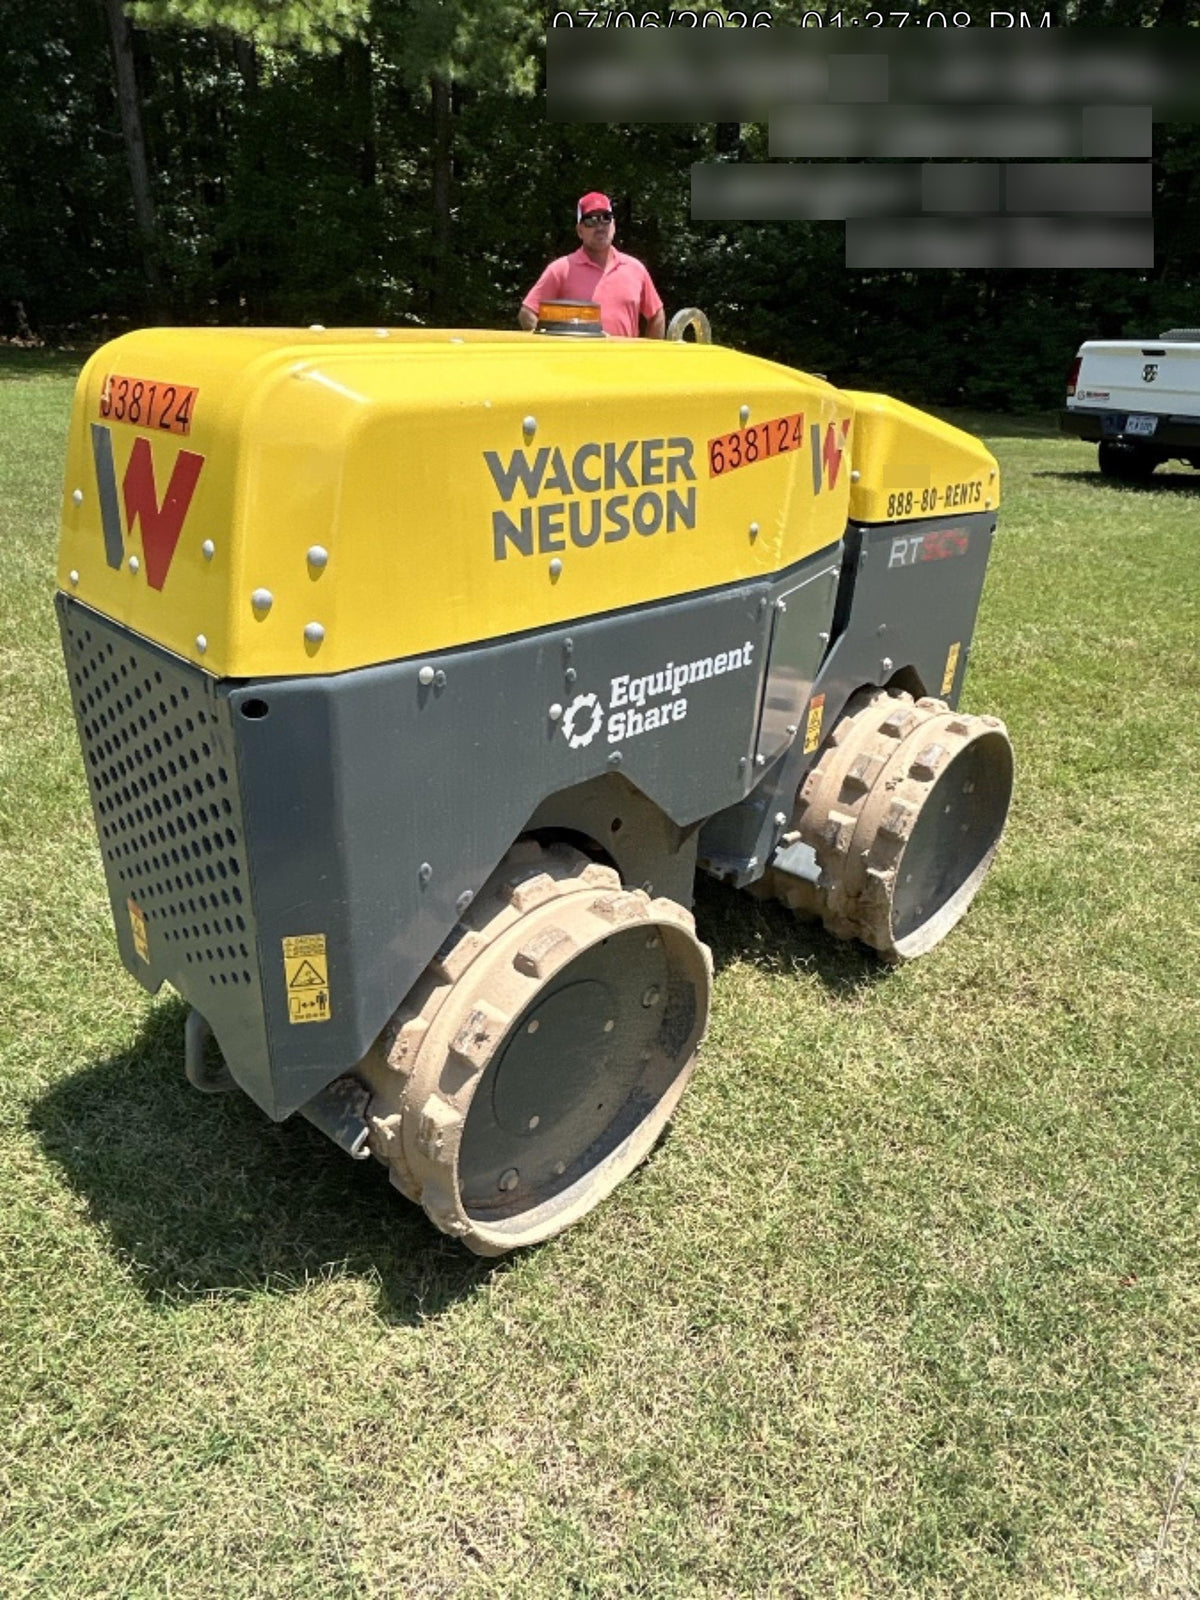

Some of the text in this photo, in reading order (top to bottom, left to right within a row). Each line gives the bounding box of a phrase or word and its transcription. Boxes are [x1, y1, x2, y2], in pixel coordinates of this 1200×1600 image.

[483, 436, 698, 503] WACKER
[710, 415, 802, 475] 638124
[493, 486, 697, 562] NEUSON
[886, 481, 982, 518] 888-80-RENTS
[609, 640, 755, 708] Equipment
[606, 698, 688, 744] Share
